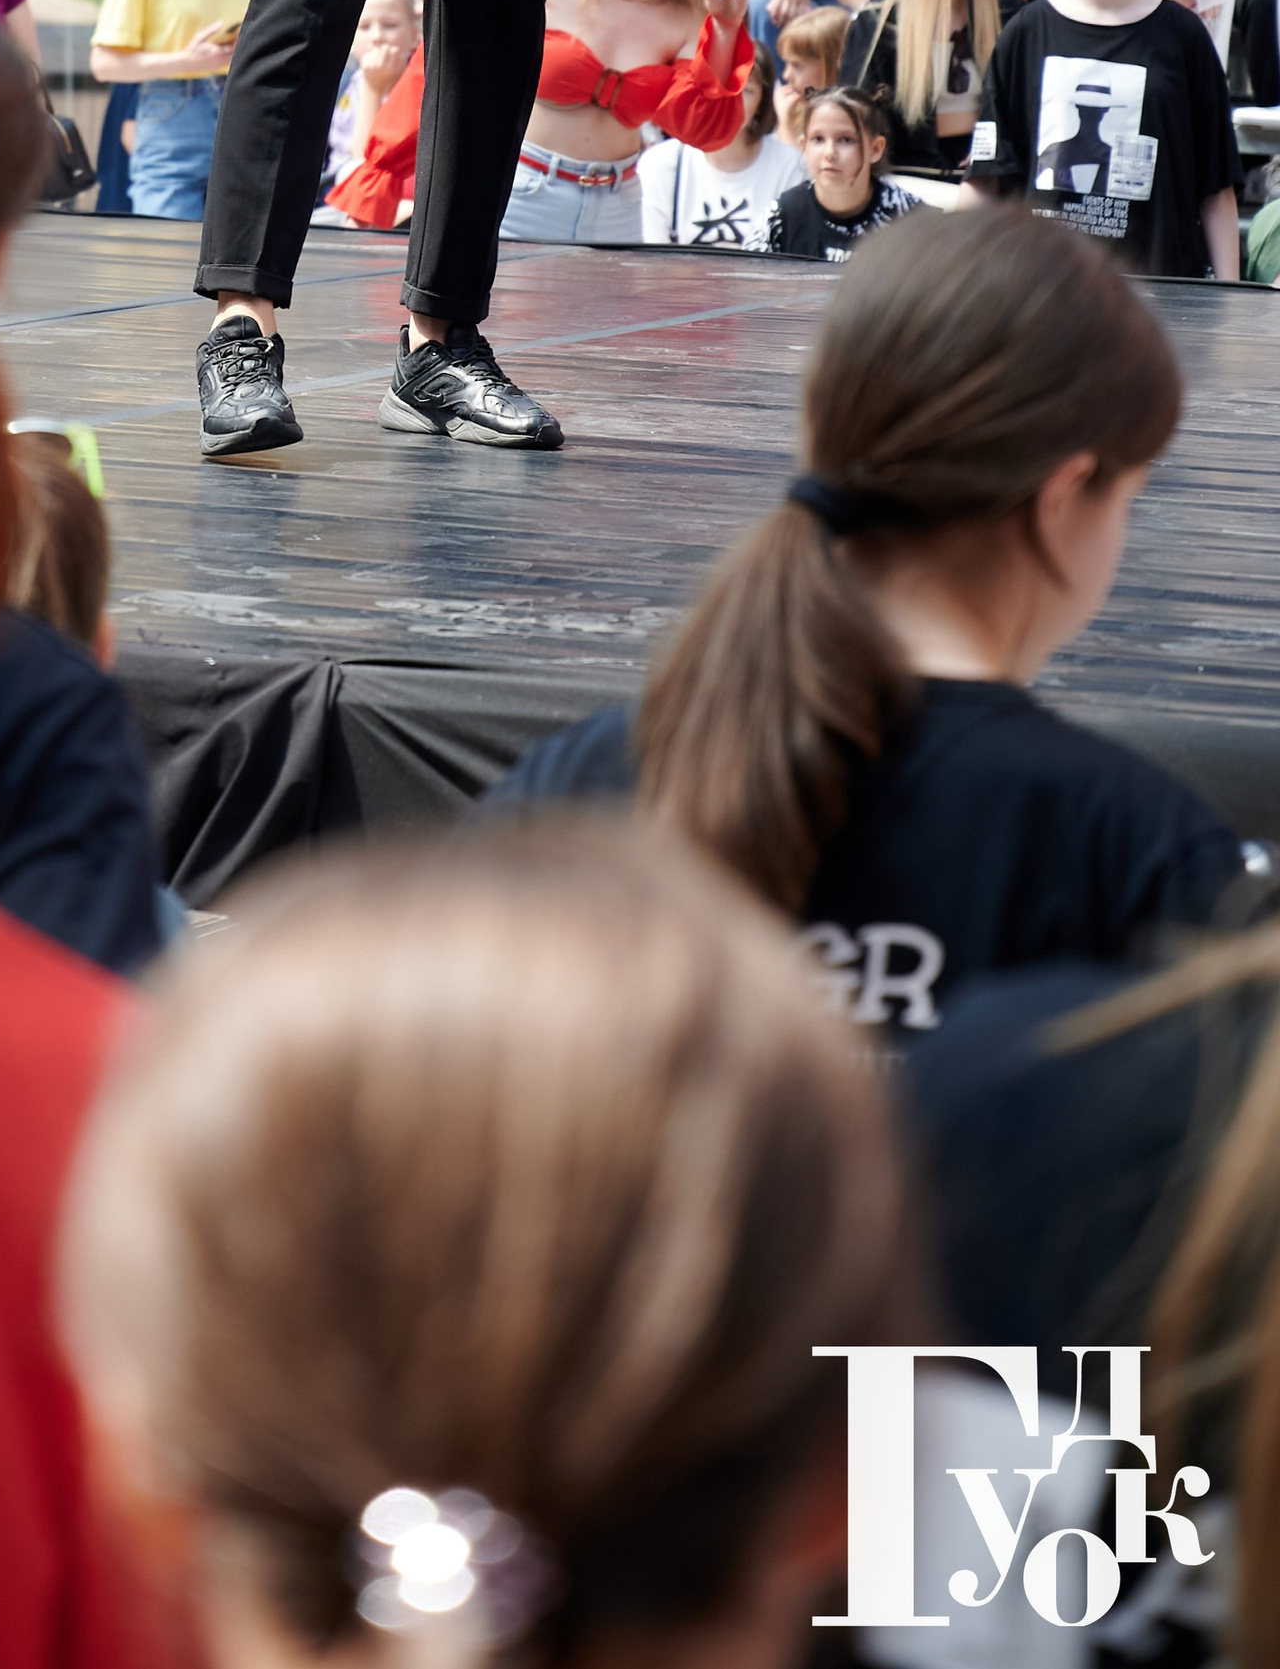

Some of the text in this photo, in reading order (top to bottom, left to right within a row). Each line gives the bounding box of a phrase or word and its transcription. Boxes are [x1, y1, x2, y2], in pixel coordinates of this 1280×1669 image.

[1063, 202, 1086, 213] HAPPEN
[1104, 208, 1113, 217] OF
[1082, 195, 1130, 210] EVENTS OF HYPE
[1098, 216, 1119, 228] PLACES
[1119, 218, 1128, 229] TO
